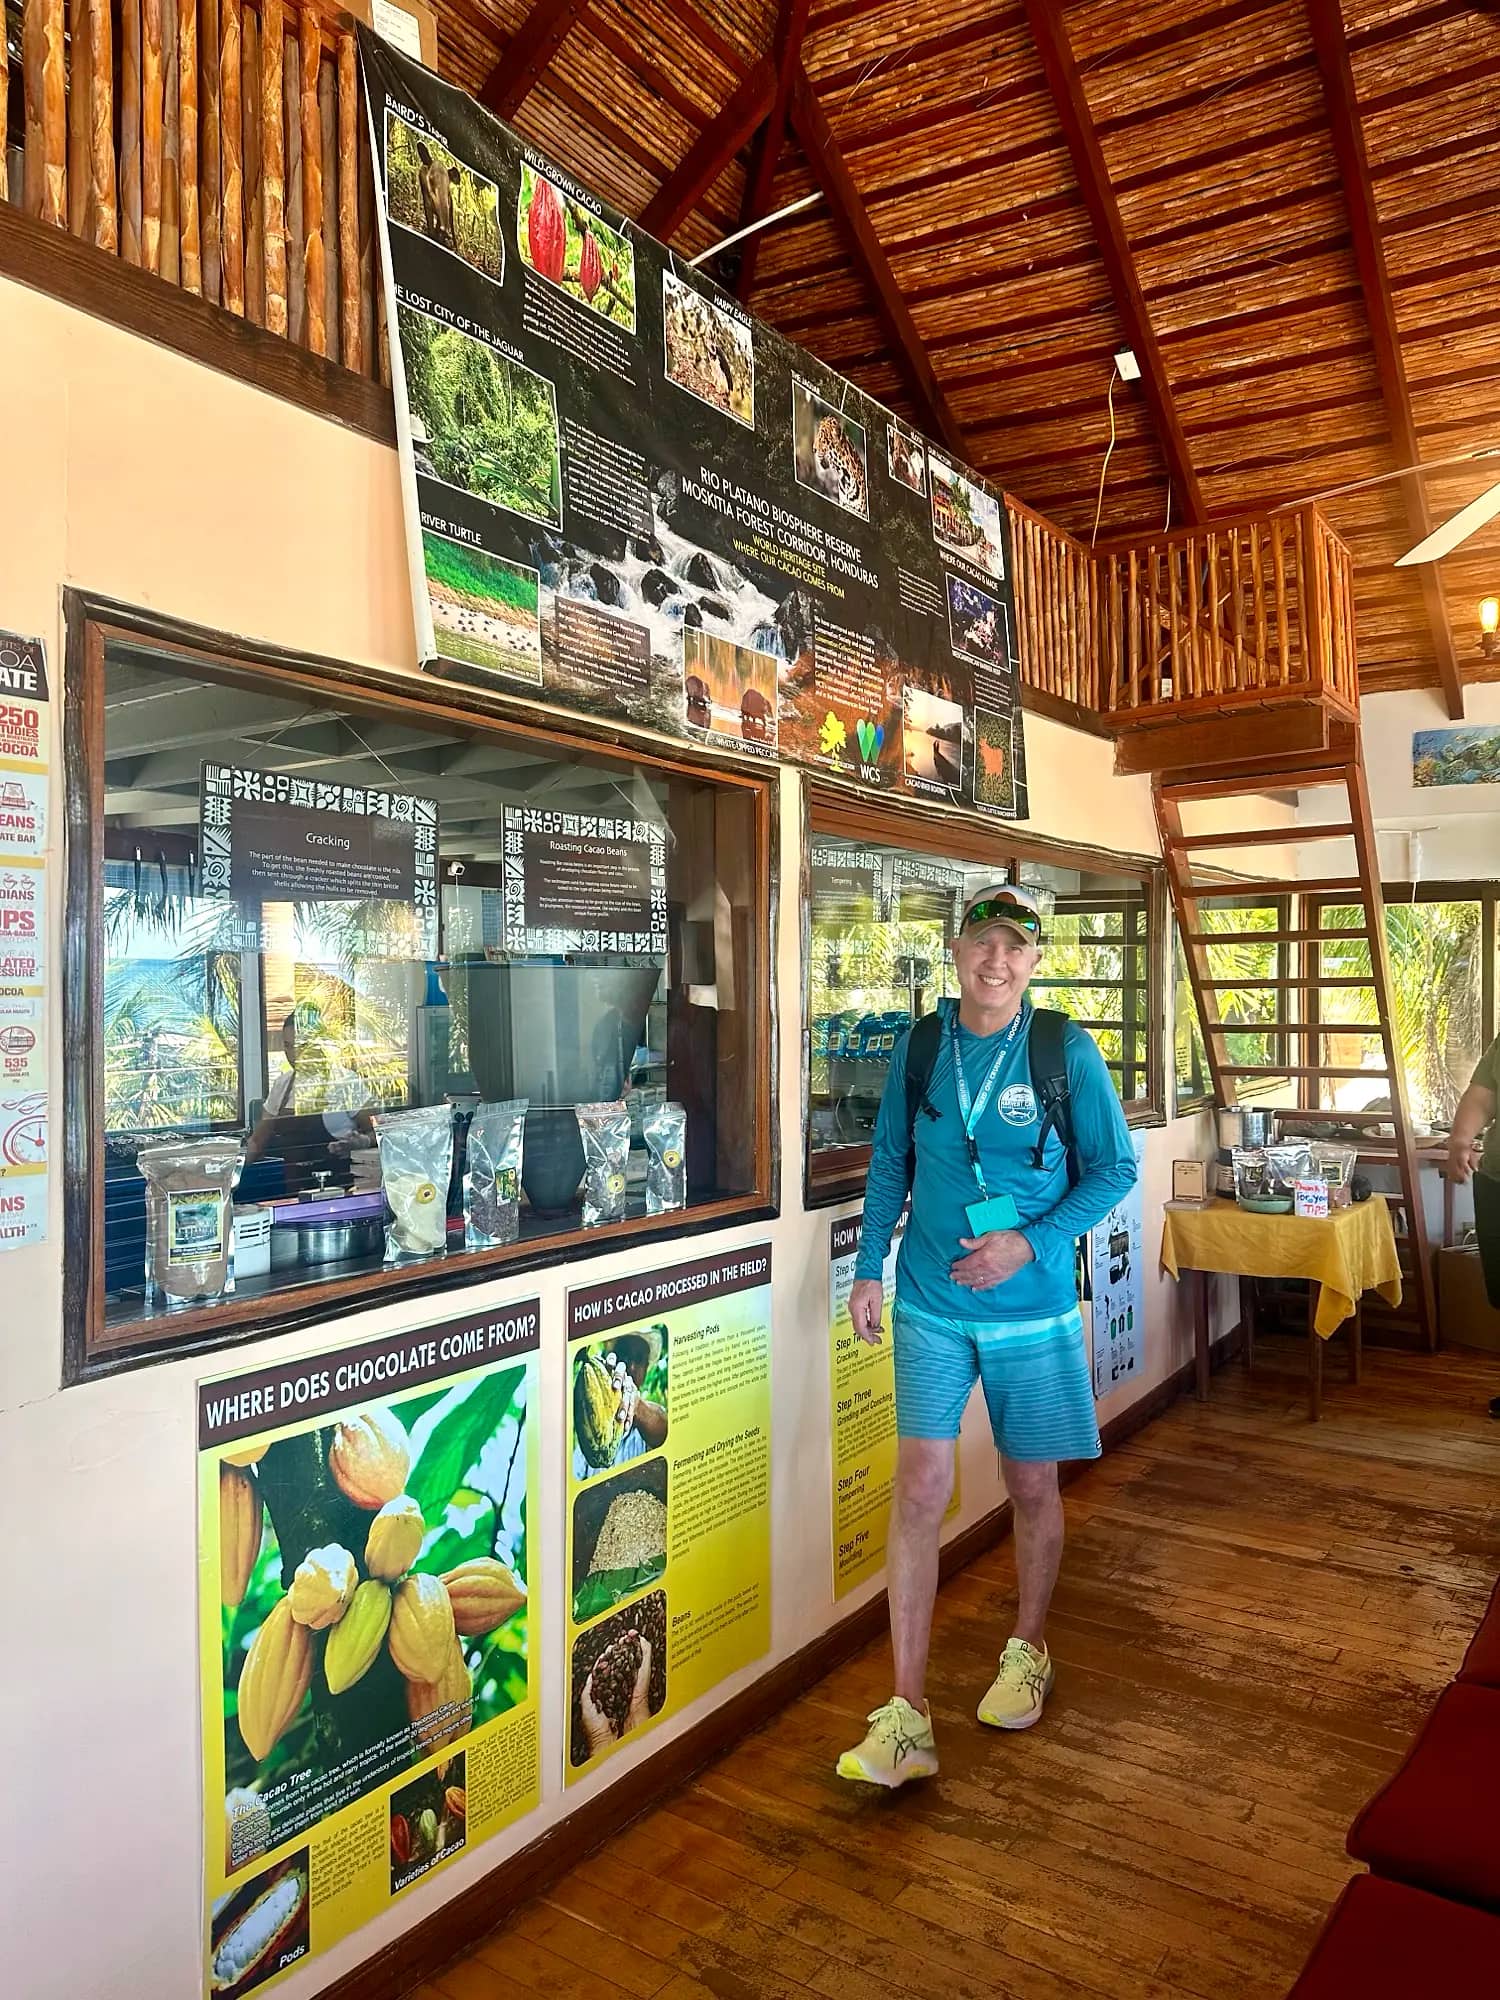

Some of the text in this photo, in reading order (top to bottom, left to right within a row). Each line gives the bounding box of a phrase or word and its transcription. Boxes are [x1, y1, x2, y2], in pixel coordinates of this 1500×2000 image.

[385, 93, 425, 128] BAIRD'S
[524, 150, 602, 215] WILD-GROWN CACAO
[405, 288, 525, 362] LOST CITY OF THE JAGUAR
[713, 294, 753, 327] HARPY EAGLE
[421, 512, 482, 545] RIVER TURTLE
[700, 466, 862, 563] RIO PLATANO BIOSPHERE RESERVE
[682, 476, 879, 589] MOSKITIA FOREST CORRIDOR, HONDURAS
[733, 538, 845, 599] WHERE OUR CACAO COMES FROM
[752, 534, 826, 578] WORLD HERITAGE SITE
[860, 764, 881, 783] WCS
[17, 834, 36, 843] BAR
[306, 832, 350, 850] Cracking
[550, 841, 628, 857] Roasting Cacao Beans
[249, 850, 260, 859] The
[261, 852, 273, 860] part
[275, 853, 281, 861] of
[282, 854, 292, 862] the
[294, 855, 307, 864] bean
[308, 857, 327, 866] needed
[329, 859, 335, 867] to
[305, 866, 324, 874] freshly
[251, 868, 265, 877] then
[329, 876, 345, 885] which
[1007, 1014, 1021, 1042] HOOKED
[834, 1227, 854, 1248] HOW
[836, 1265, 849, 1277] Step
[574, 1258, 767, 1323] HOW IS CACAO PROCESSED IN THE FIELD?
[673, 1324, 720, 1346] Harvesting Pods
[836, 1335, 850, 1351] Step
[206, 1314, 536, 1429] WHERE DOES CHOCOLATE COME FROM?
[837, 1386, 871, 1413] Step Three
[861, 1402, 870, 1415] and
[673, 1425, 759, 1470] Fermenting and Drying the Seeds
[838, 1464, 869, 1492] Step Four
[838, 1528, 869, 1558] Step Five
[672, 1609, 691, 1628] Beans
[285, 1787, 299, 1801] from
[300, 1782, 309, 1793] the
[310, 1772, 327, 1787] cacao
[342, 1753, 358, 1769] which
[364, 1738, 385, 1756] formally
[386, 1728, 403, 1744] known
[232, 1768, 312, 1818] The Cacao Tree
[282, 1810, 304, 1830] delicate
[305, 1800, 322, 1816] plants
[323, 1793, 334, 1806] that
[362, 1760, 389, 1782] understory
[293, 1793, 305, 1806] only
[312, 1783, 321, 1795] the
[322, 1777, 332, 1789] hot
[333, 1771, 344, 1783] and
[344, 1762, 358, 1776] rainy
[310, 1807, 323, 1820] from
[394, 1838, 464, 1890] Varieties of Cacao
[279, 1945, 305, 1969] Pods
